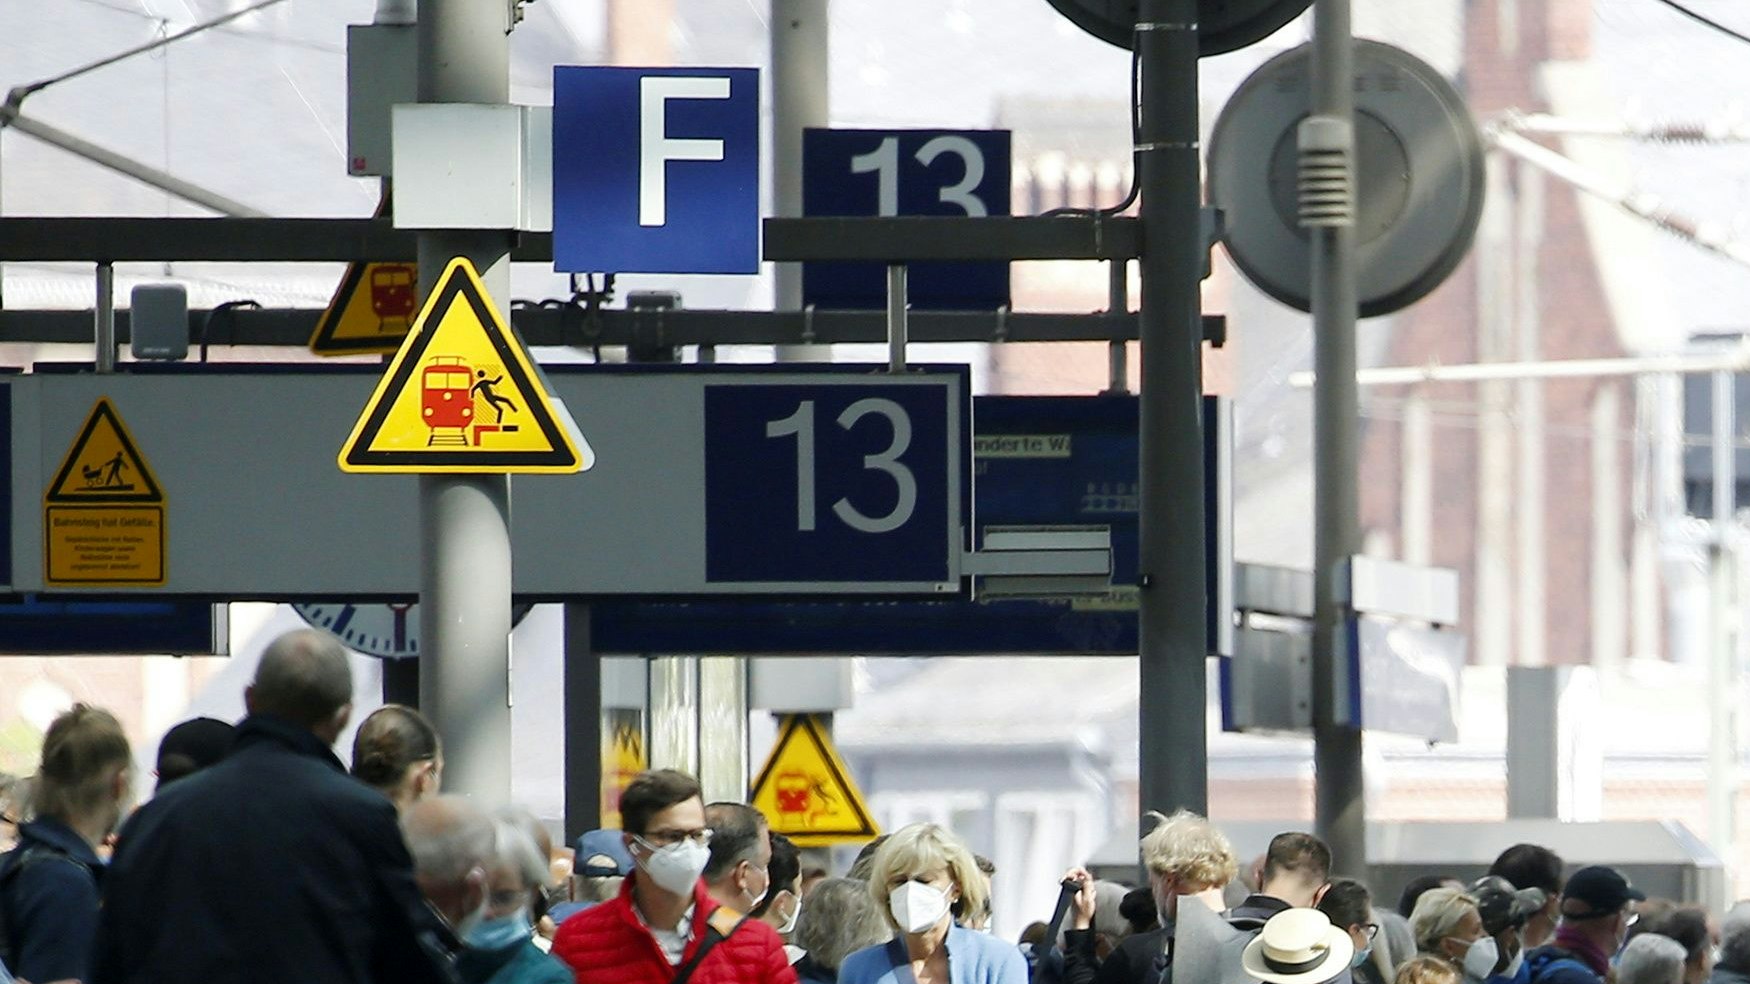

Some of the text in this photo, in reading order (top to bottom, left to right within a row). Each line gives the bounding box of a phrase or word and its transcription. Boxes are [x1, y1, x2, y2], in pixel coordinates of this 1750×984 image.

[640, 76, 730, 227] F
[851, 135, 987, 217] 13
[766, 397, 917, 534] 13
[974, 437, 1042, 451] nderte
